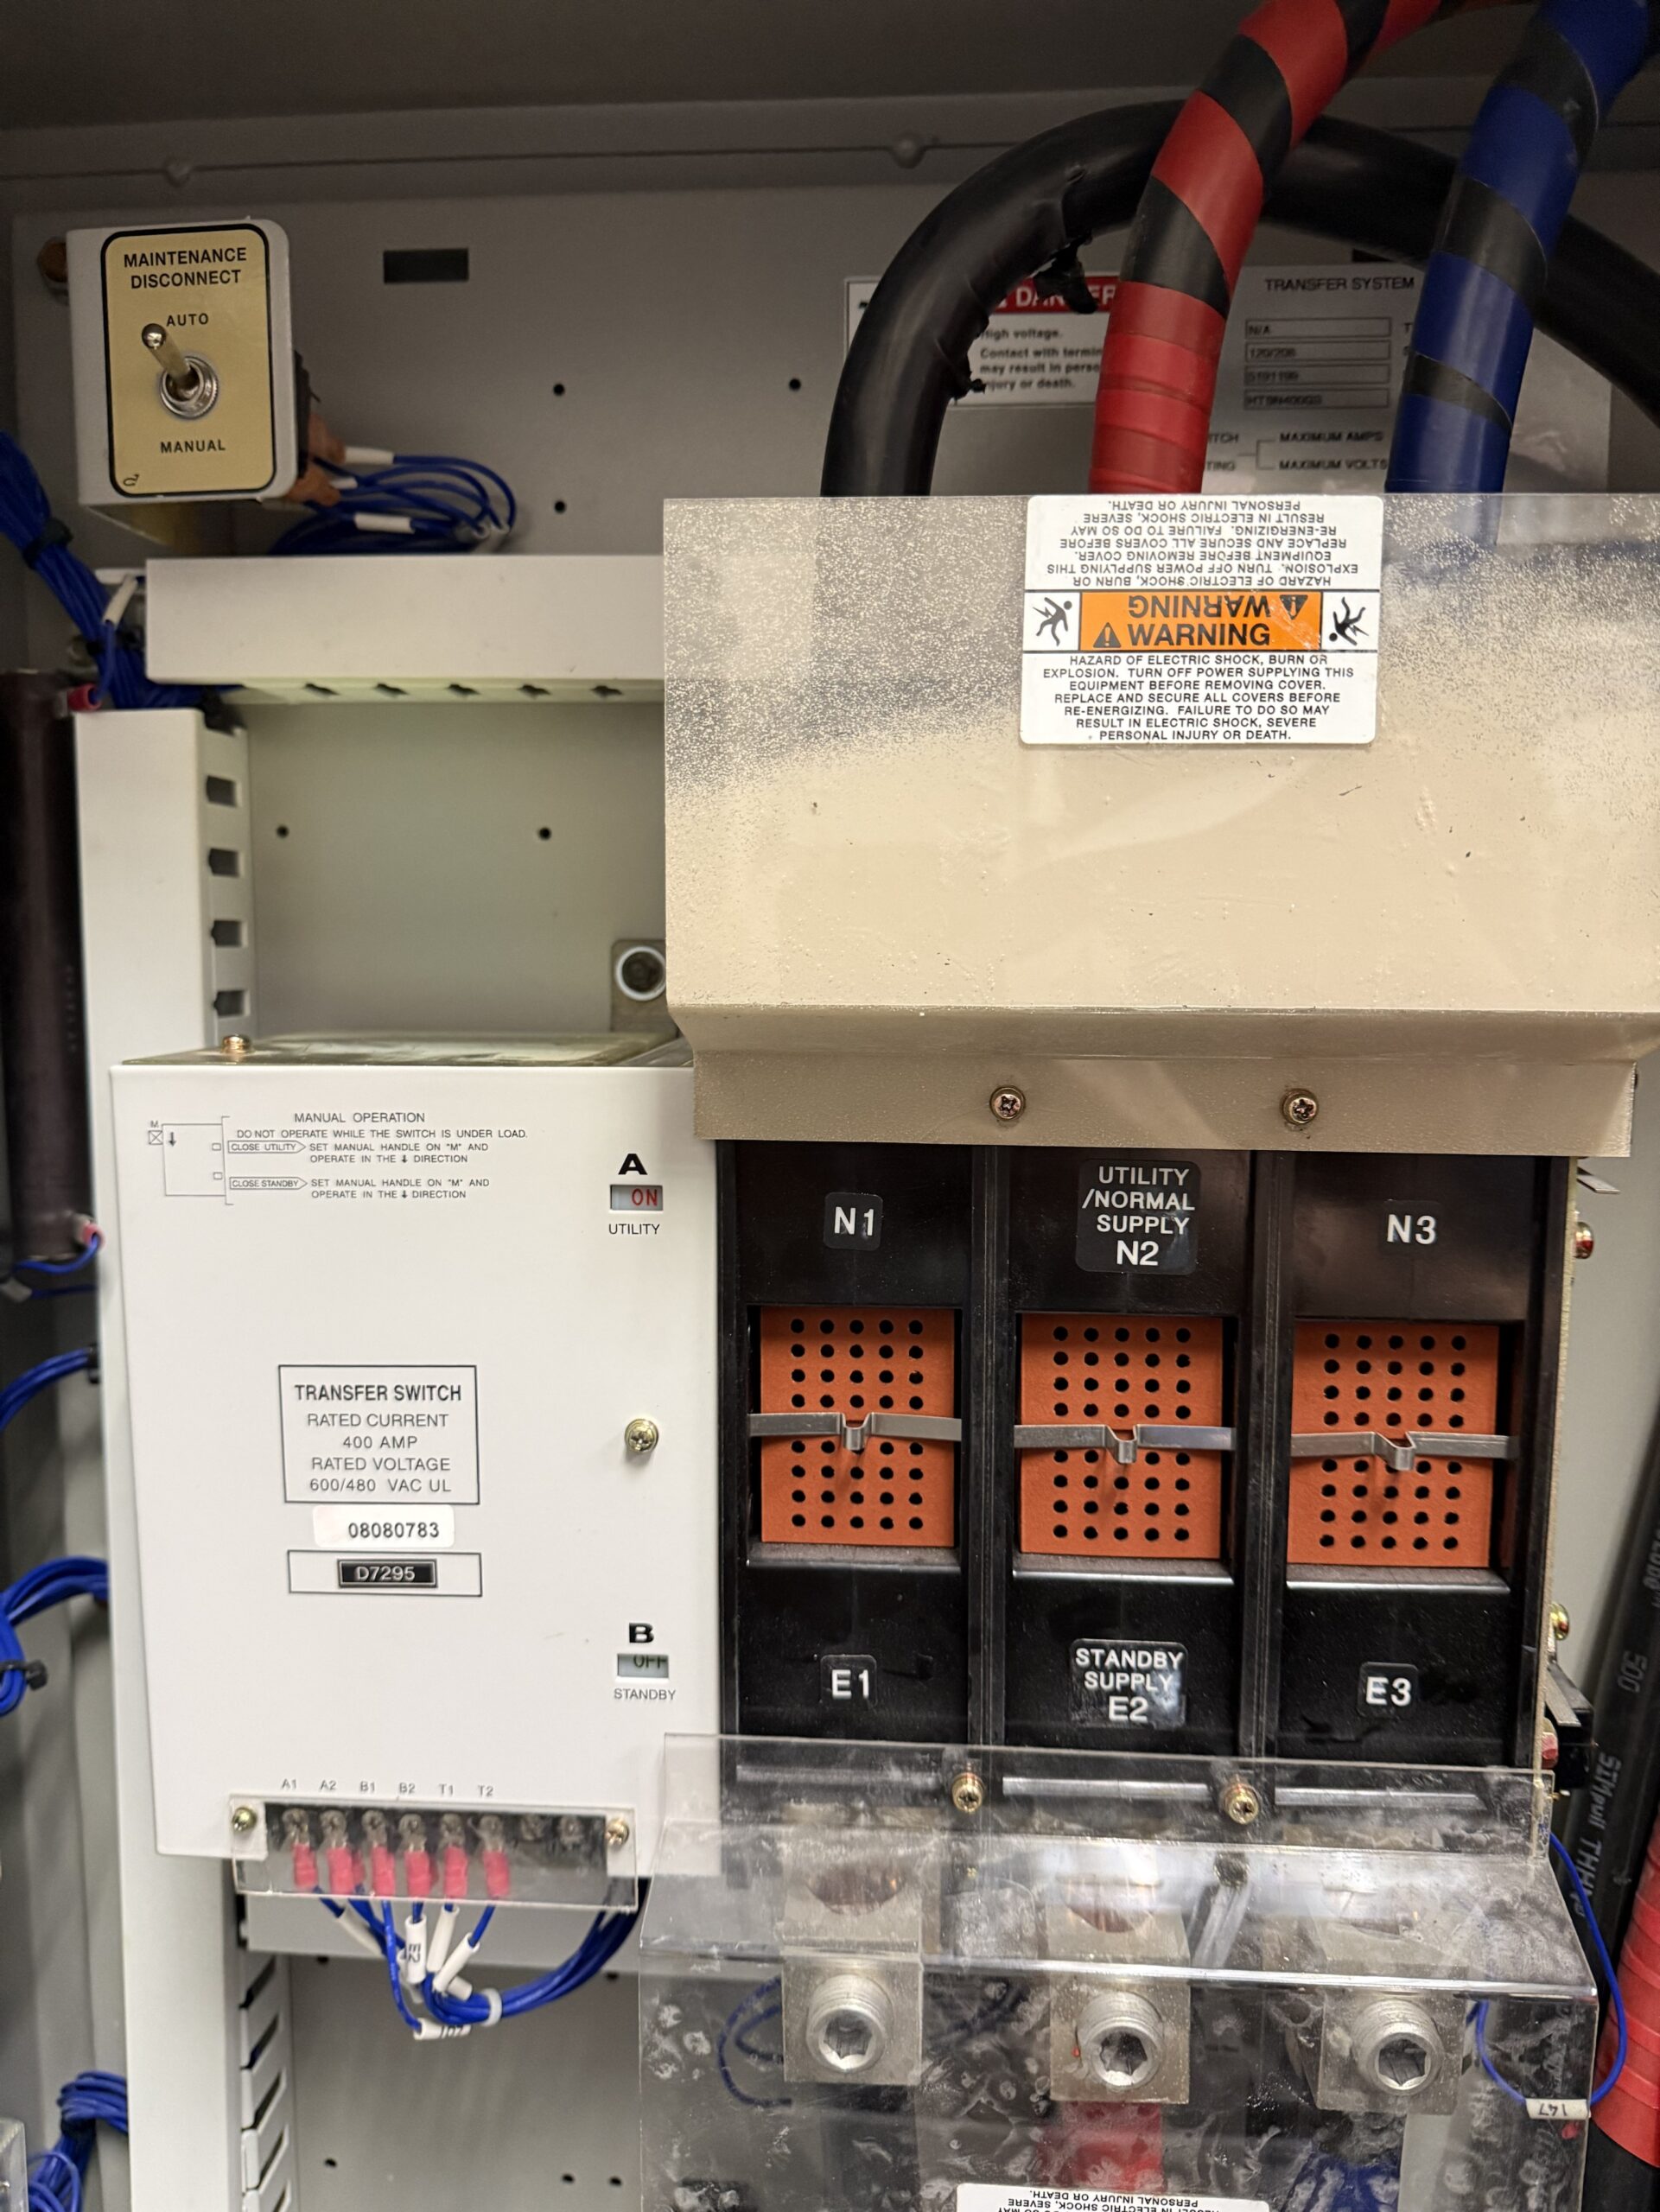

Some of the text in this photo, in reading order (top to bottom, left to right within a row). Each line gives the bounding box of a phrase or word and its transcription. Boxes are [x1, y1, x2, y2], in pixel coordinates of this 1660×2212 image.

[124, 247, 247, 268] MAINTENANCE
[131, 270, 241, 289] DISCONNECT
[1265, 276, 1415, 291] TRANSFER SYSTEM
[166, 313, 209, 327] AUTO
[1014, 328, 1062, 340] voltage.
[980, 347, 1103, 359] Contact with termin
[980, 365, 1005, 375] may
[1009, 364, 1046, 373] result
[1050, 363, 1061, 372] in
[1020, 379, 1033, 388] or
[1038, 378, 1076, 388] death.
[1279, 432, 1341, 443] MAXIMUM
[1346, 431, 1383, 442] AMPS
[161, 439, 226, 454] MANUAL
[1279, 460, 1341, 471] MAXIMUM
[1345, 459, 1388, 470] VOLTS
[1109, 501, 1300, 511] PERSONAL INJURY OR DEATH.
[1129, 594, 1271, 619] WARNING
[1128, 623, 1270, 646] WARNING
[1071, 654, 1327, 665] HAZARD OF ELECTRIC SHOCK, BURN OR
[1044, 667, 1353, 677] EXPLOSION. TURN OFF POWER SUPPLYING THIS
[1070, 680, 1325, 690] EQUIPMENT BEFORE REMOVING COVER.
[1055, 693, 1340, 702] REPLACE AND SECURE ALL COVERS BEFORE
[1065, 705, 1329, 715] RE-ENERGIZING. FAILURE TO DO SO MAY
[1077, 718, 1316, 728] RESULT IN ELECTRIC SHOCK, SEVERE
[1100, 730, 1290, 740] PERSONAL INJURY OR DEATH.
[295, 1112, 424, 1122] MANUAL OPERATION
[237, 1129, 527, 1138] DO NOT OPERATE WHILE THE SWITCH IS UNDER LOAD.
[619, 1154, 647, 1175] A
[1098, 1166, 1189, 1185] UTILITY
[311, 1179, 329, 1187] SET
[632, 1188, 658, 1206] ON
[1082, 1188, 1195, 1211] /NORMAL
[834, 1208, 875, 1235] N1
[1097, 1214, 1190, 1235] SUPPLY
[609, 1224, 659, 1234] UTILITY
[1386, 1215, 1436, 1245] N3
[1116, 1241, 1159, 1266] N2
[295, 1385, 461, 1401] TRANSFER SWITCH
[308, 1414, 448, 1427] RATED CURRENT
[343, 1436, 417, 1449] 400 AMP
[312, 1458, 450, 1471] RATED VOLTAGE
[309, 1478, 451, 1492] 600/480 VAC UL
[348, 1522, 439, 1538] 08080783
[354, 1565, 416, 1583] D7295
[629, 1624, 653, 1643] B
[633, 1655, 667, 1669] OFF
[1075, 1648, 1183, 1670] STANDBY
[1617, 1649, 1648, 1694] 500
[831, 1670, 870, 1698] E1
[1084, 1672, 1174, 1693] SUPPLY
[614, 1688, 676, 1700] STANDBY
[1365, 1678, 1412, 1707] E3
[1109, 1695, 1148, 1721] E2
[282, 1779, 493, 1797] A1 A2 B1 B2 T1 T2
[1588, 1751, 1622, 1829] SIMpull
[1539, 2103, 1568, 2117] 147
[1008, 2198, 1051, 2209] SEVERE
[1030, 2190, 1199, 2208] PERSONAL INJURY OR DEATH.
[1055, 2201, 1098, 2212] SHOCK,
